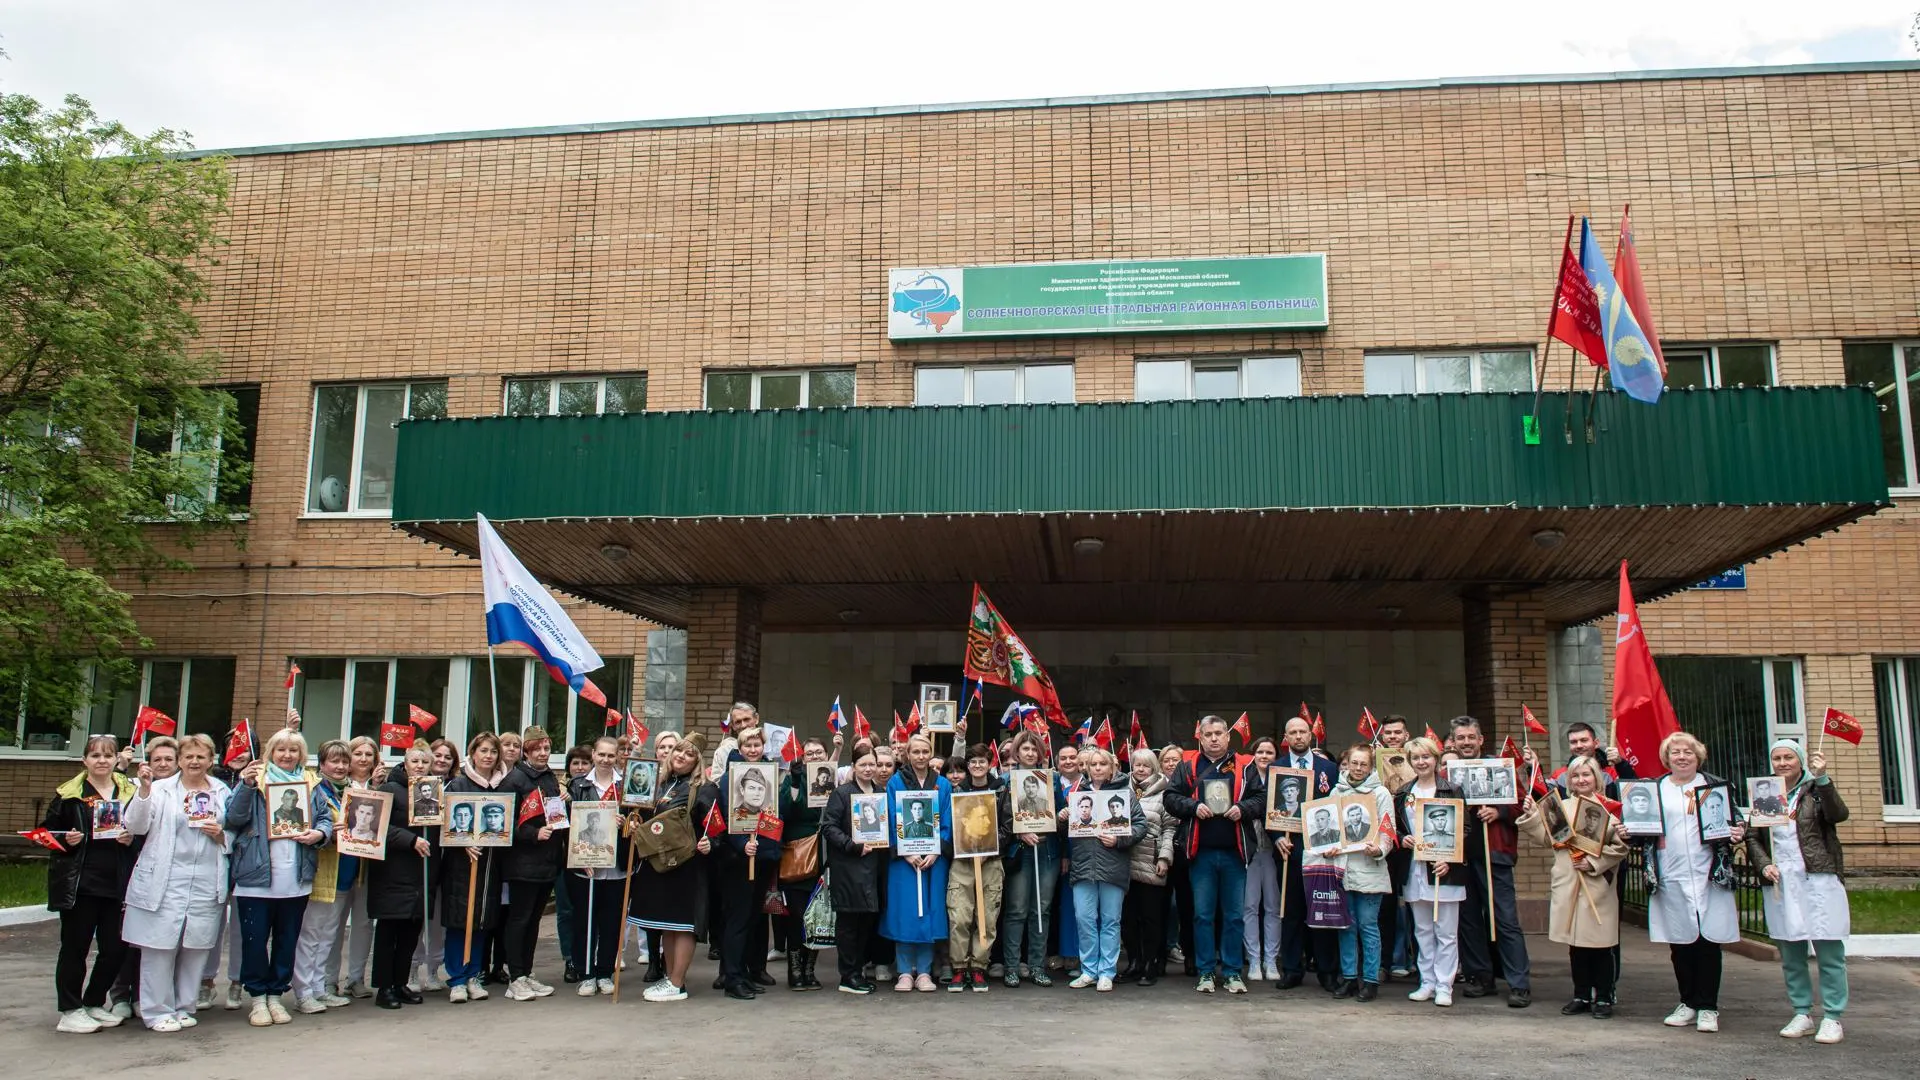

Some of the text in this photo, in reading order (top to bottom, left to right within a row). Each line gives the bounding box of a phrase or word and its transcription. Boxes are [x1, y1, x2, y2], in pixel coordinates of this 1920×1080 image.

[1180, 280, 1240, 288] здравоохранения
[967, 298, 1319, 319] СОЛНЕЧНОГОРСКАЯ ЦЕНТРАЛЬНАЯ РАЙОННАЯ БОЛЬНИЦА
